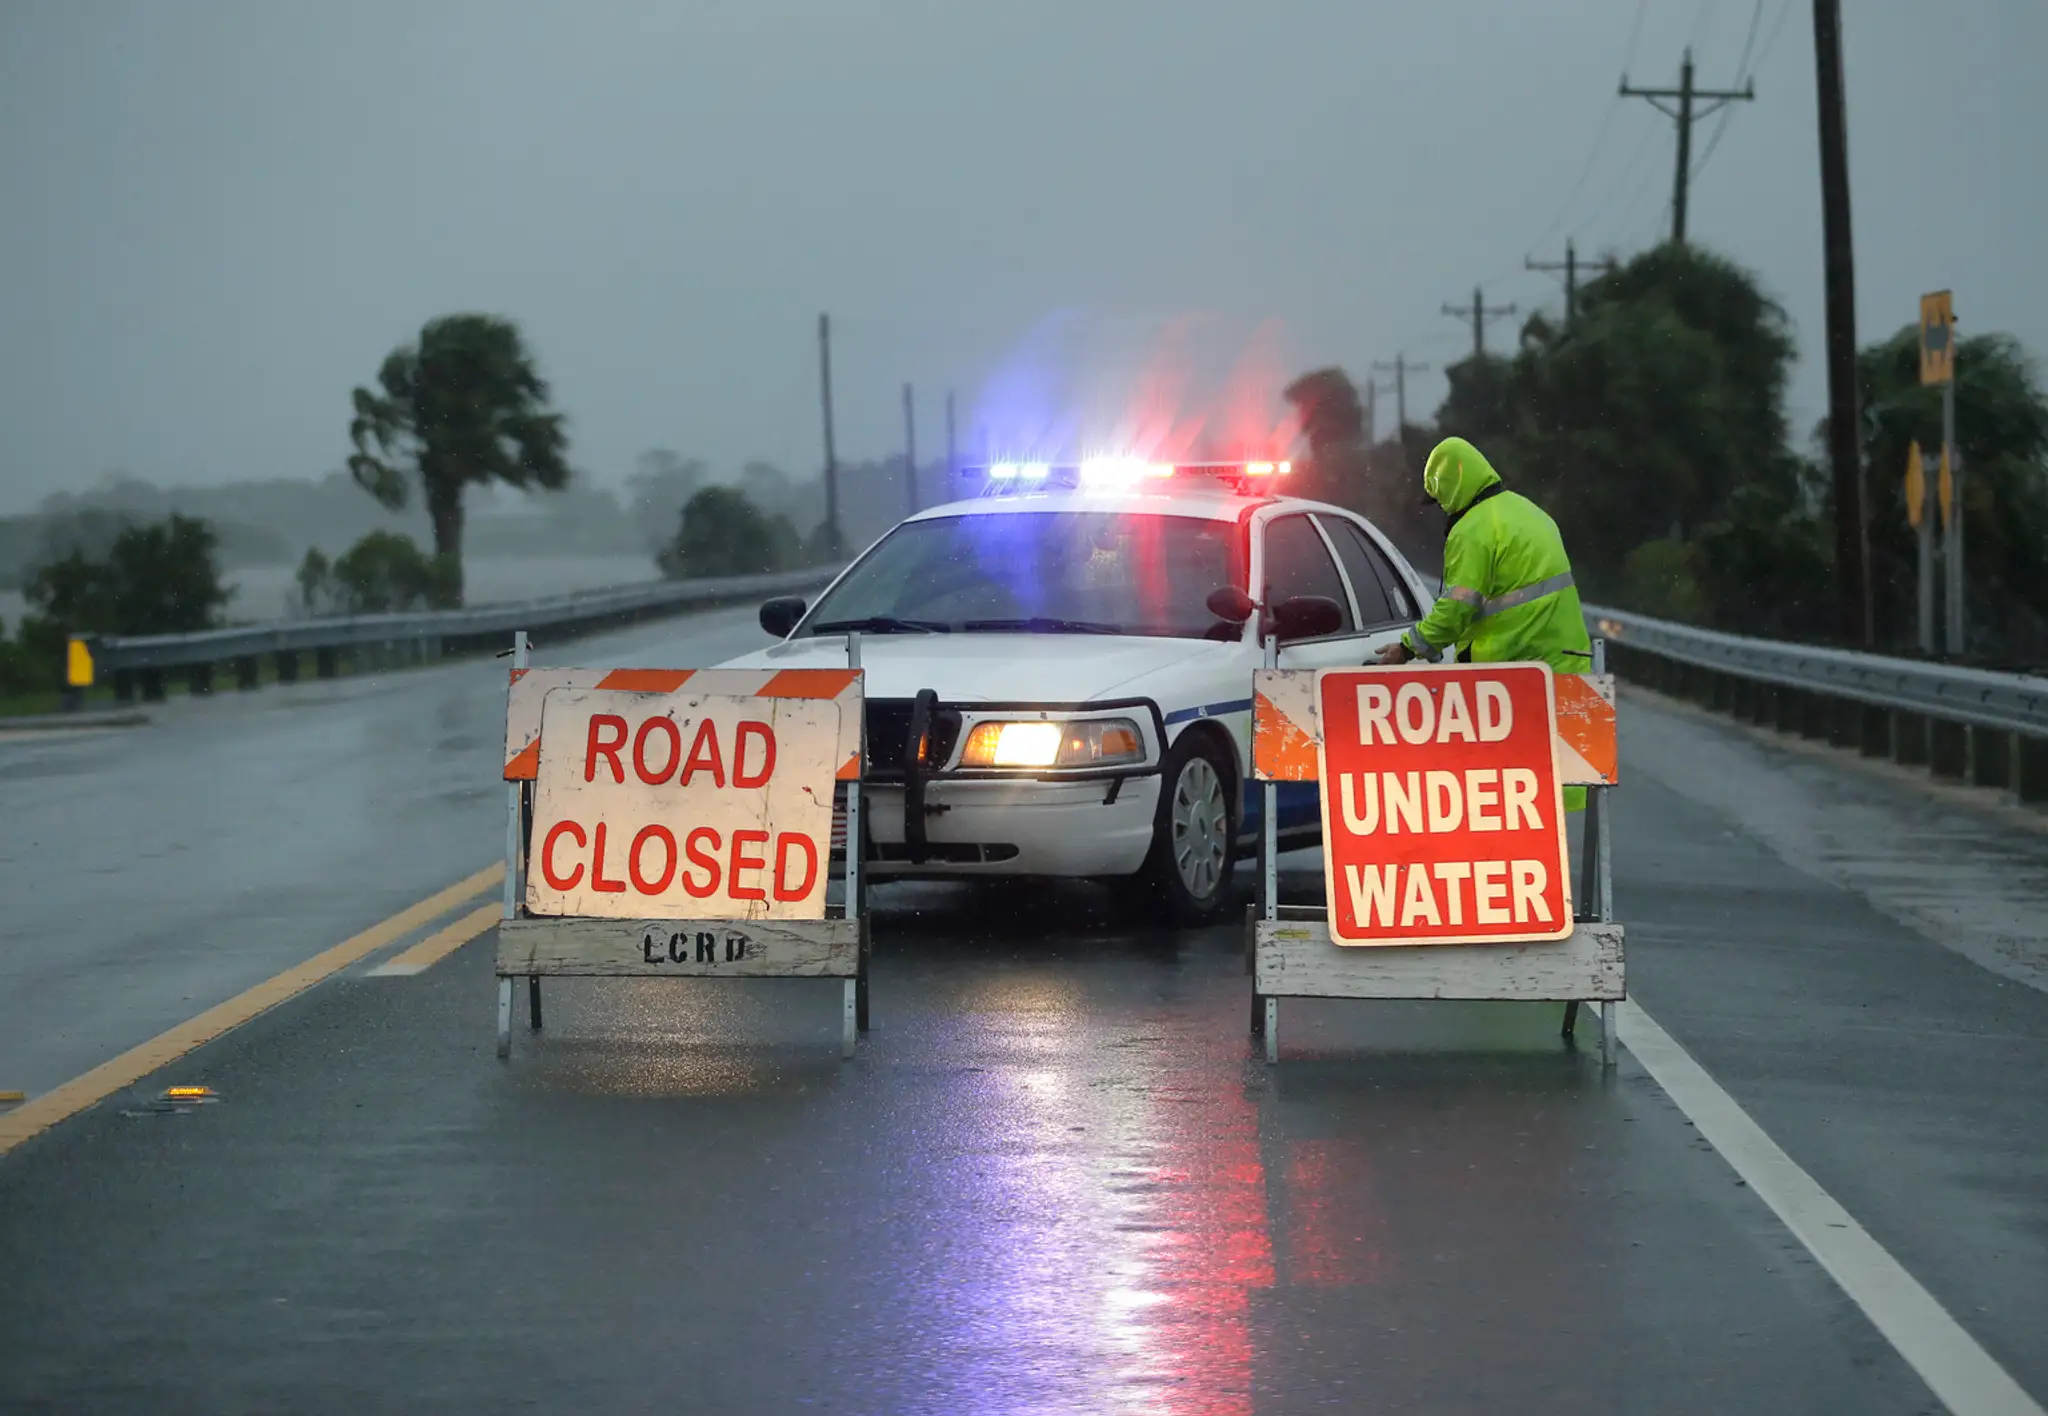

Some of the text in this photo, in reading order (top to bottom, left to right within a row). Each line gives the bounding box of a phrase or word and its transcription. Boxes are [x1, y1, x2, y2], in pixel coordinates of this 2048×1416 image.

[1356, 681, 1513, 745] ROAD
[584, 714, 776, 788] ROAD
[1340, 768, 1545, 836] UNDER
[542, 820, 818, 902] CLOSED
[1344, 859, 1554, 928] WATER
[643, 931, 750, 963] LCRD
